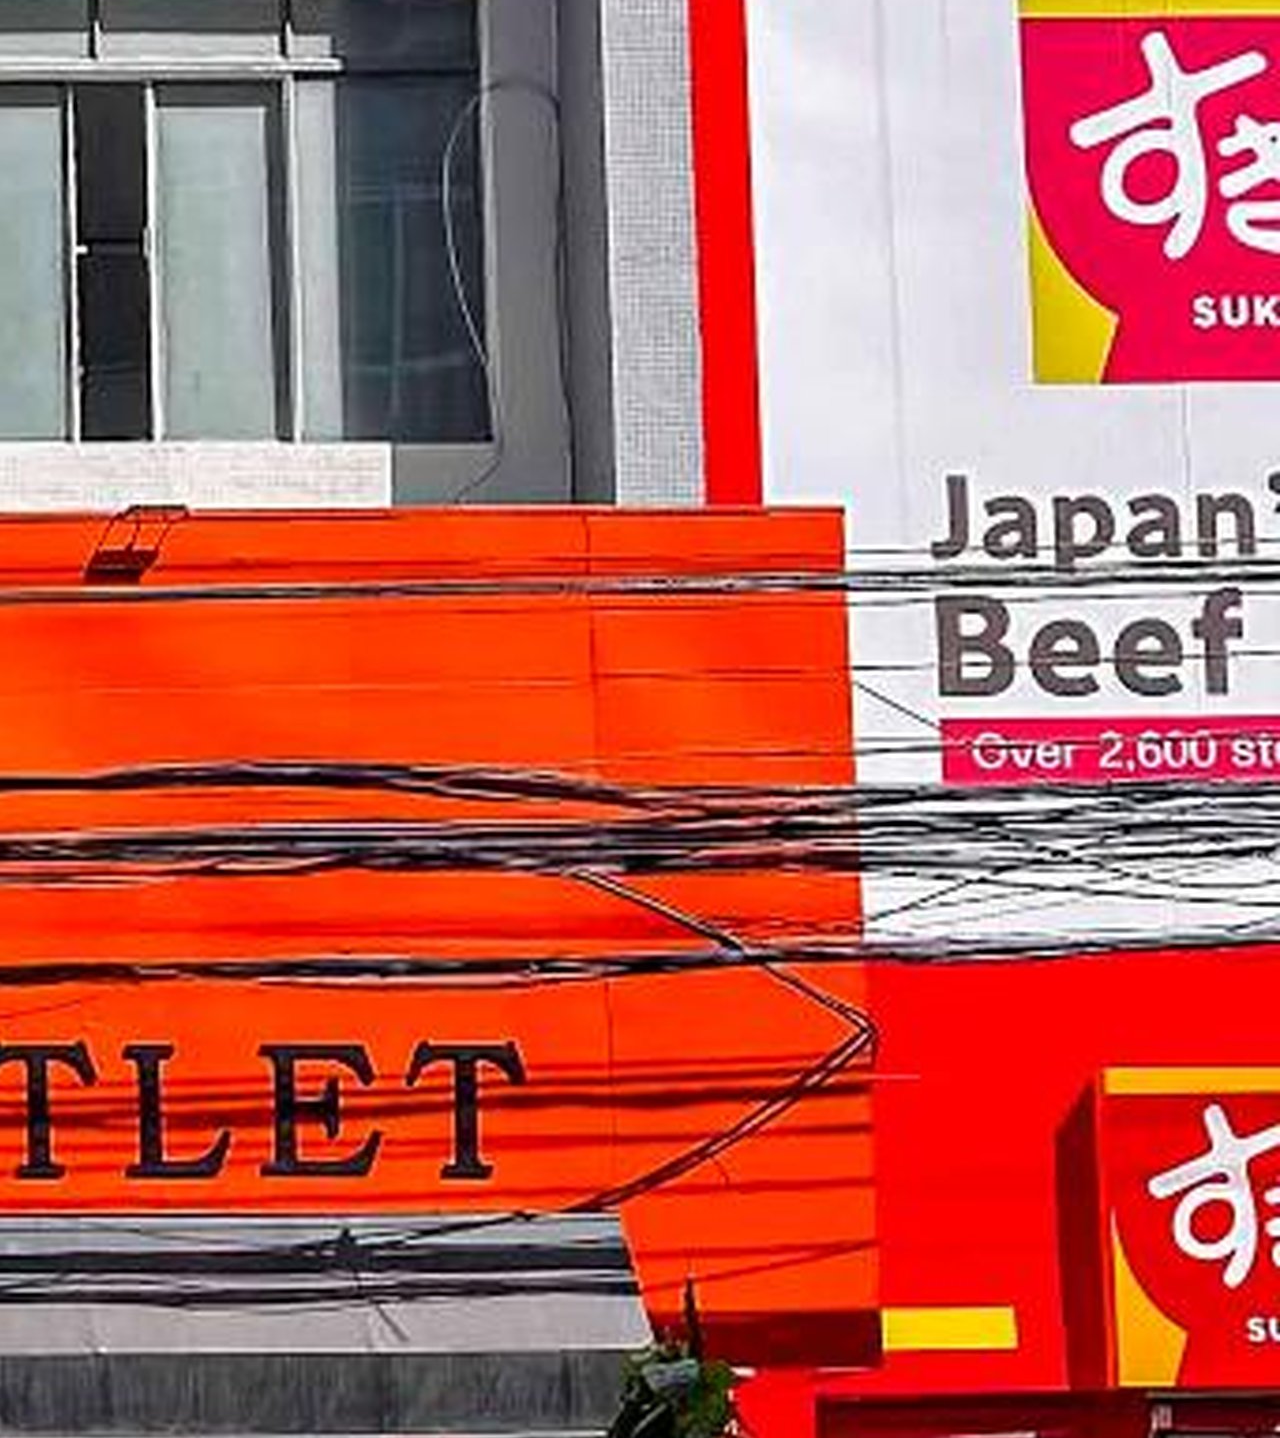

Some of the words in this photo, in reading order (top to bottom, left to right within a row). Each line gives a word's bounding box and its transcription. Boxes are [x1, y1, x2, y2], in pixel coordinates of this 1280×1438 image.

[935, 587, 1243, 696] Beef
[971, 732, 1076, 769] Over
[1098, 731, 1217, 771] 2,600
[1230, 732, 1280, 769] st
